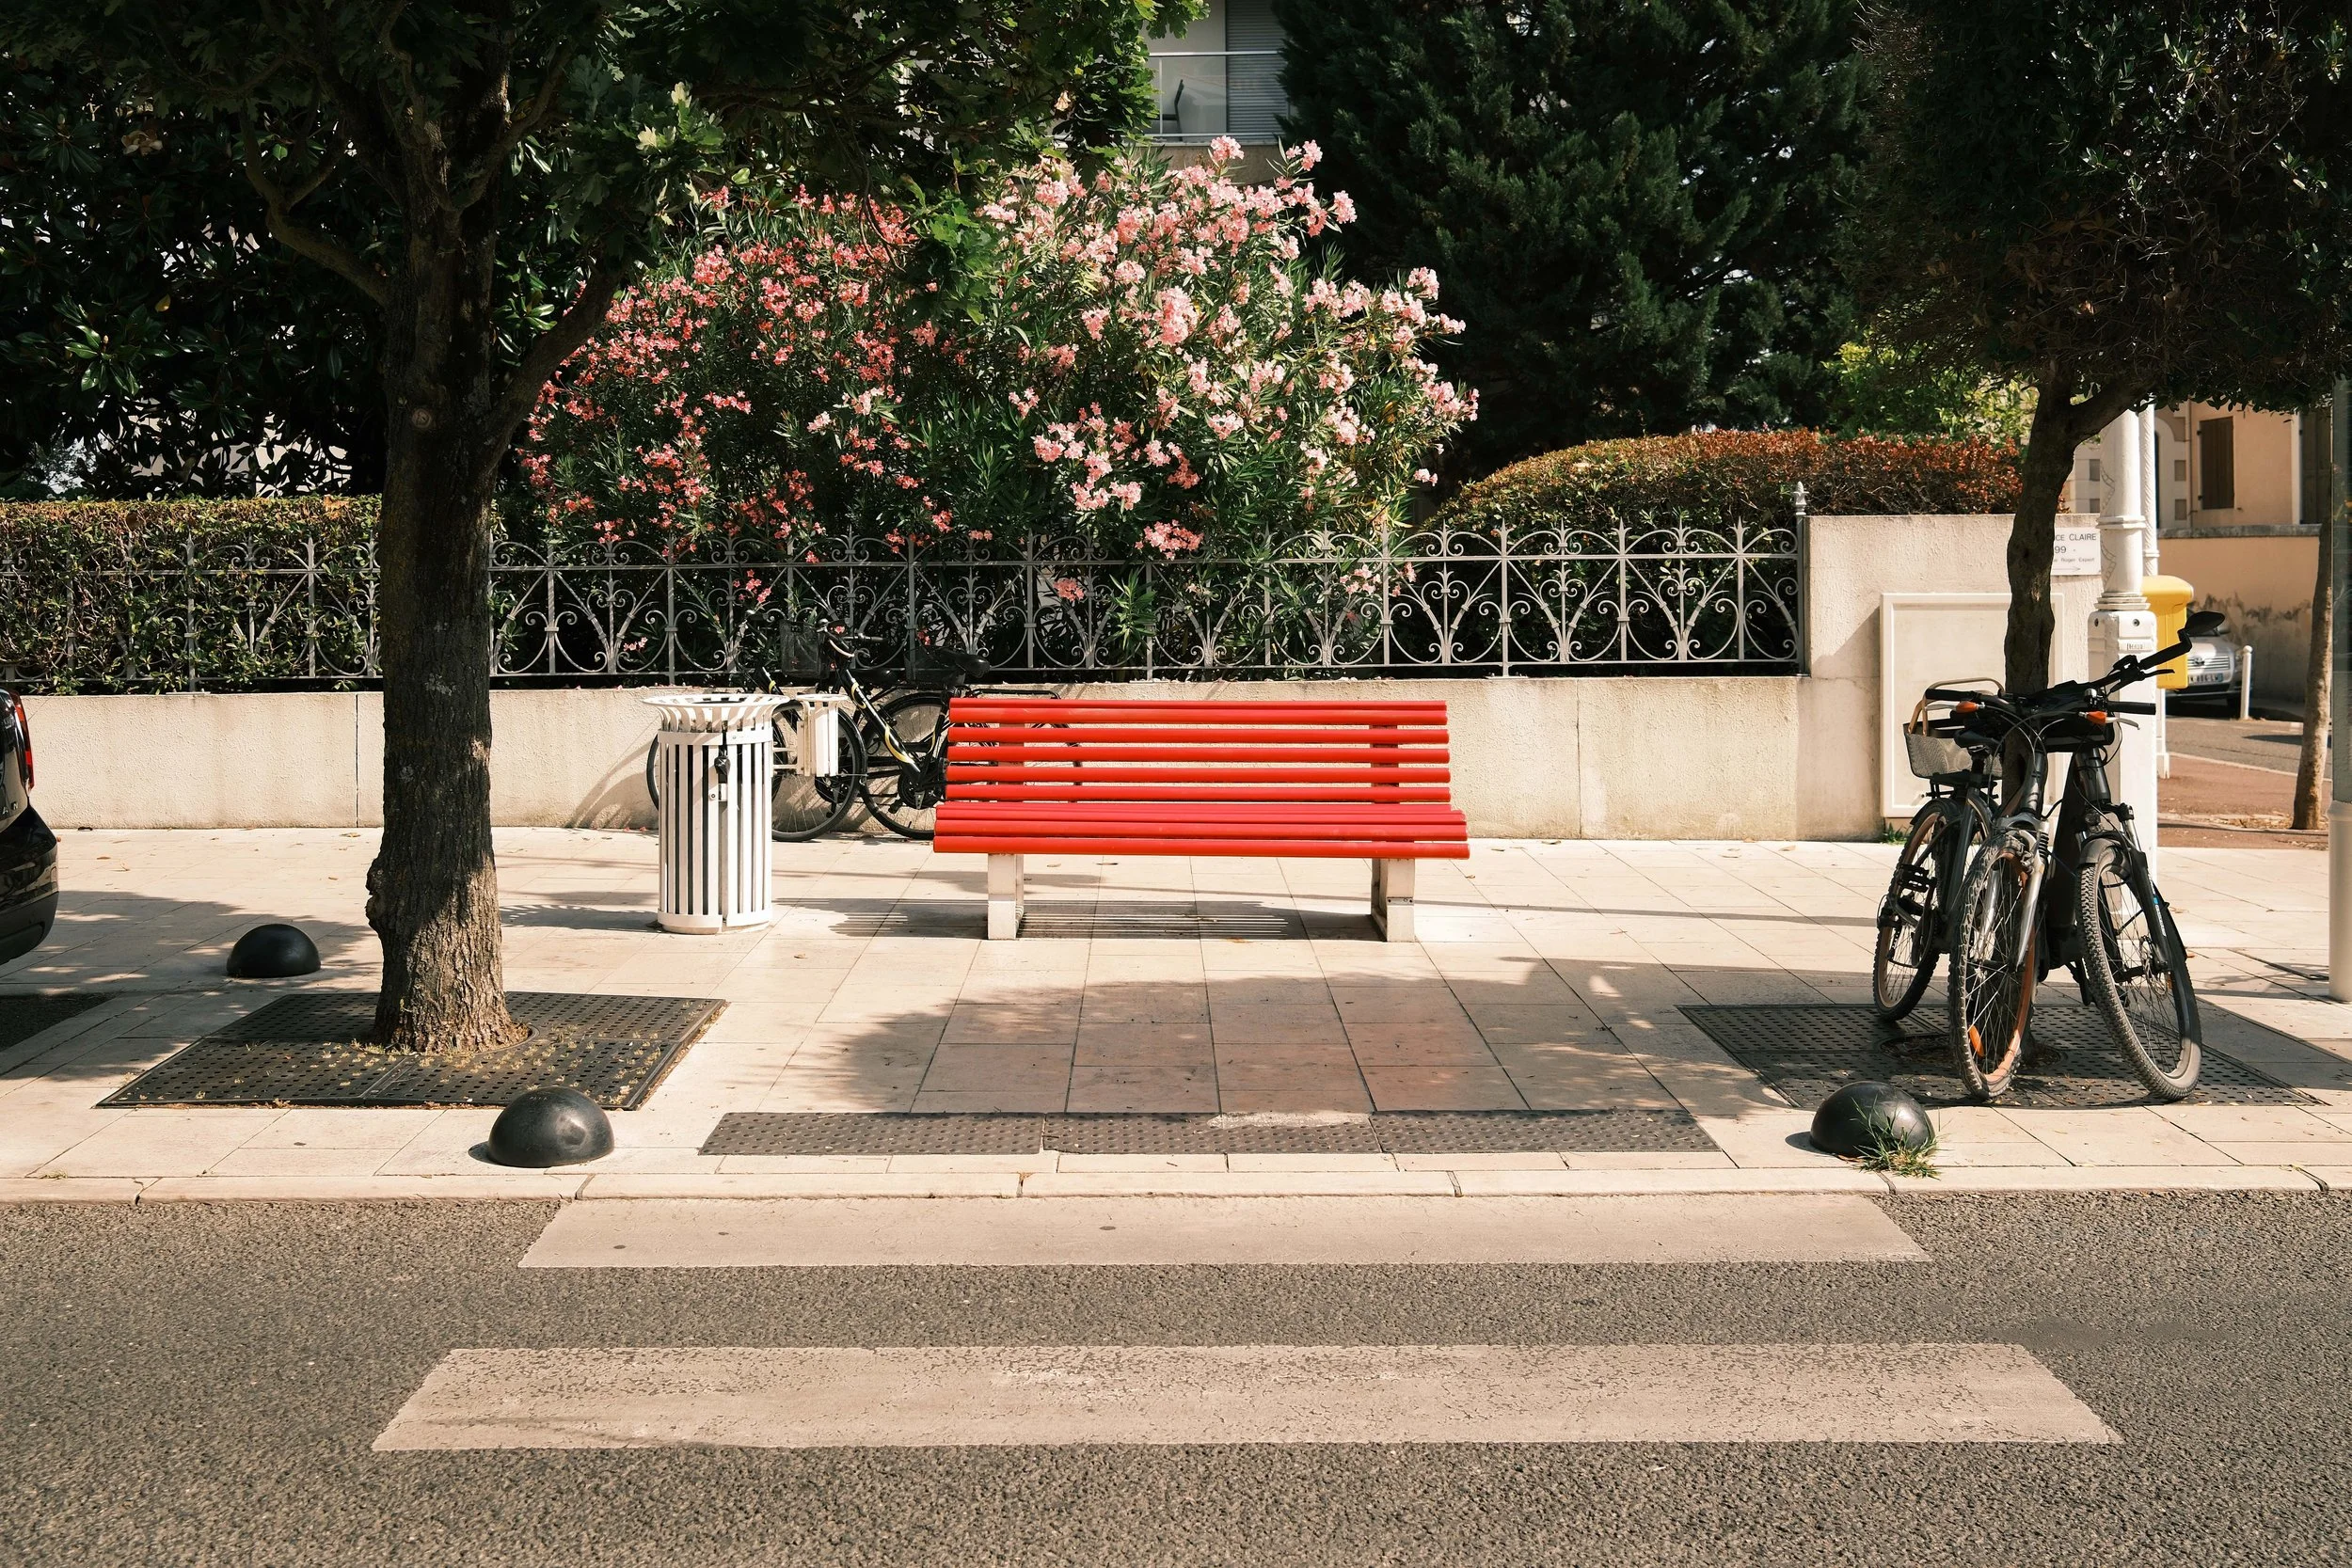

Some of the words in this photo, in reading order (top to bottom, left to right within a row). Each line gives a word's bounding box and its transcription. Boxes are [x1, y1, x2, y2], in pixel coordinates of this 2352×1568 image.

[2069, 533, 2097, 542] CLAIRE
[2054, 546, 2067, 554] 99
[2, 801, 19, 815] AN
